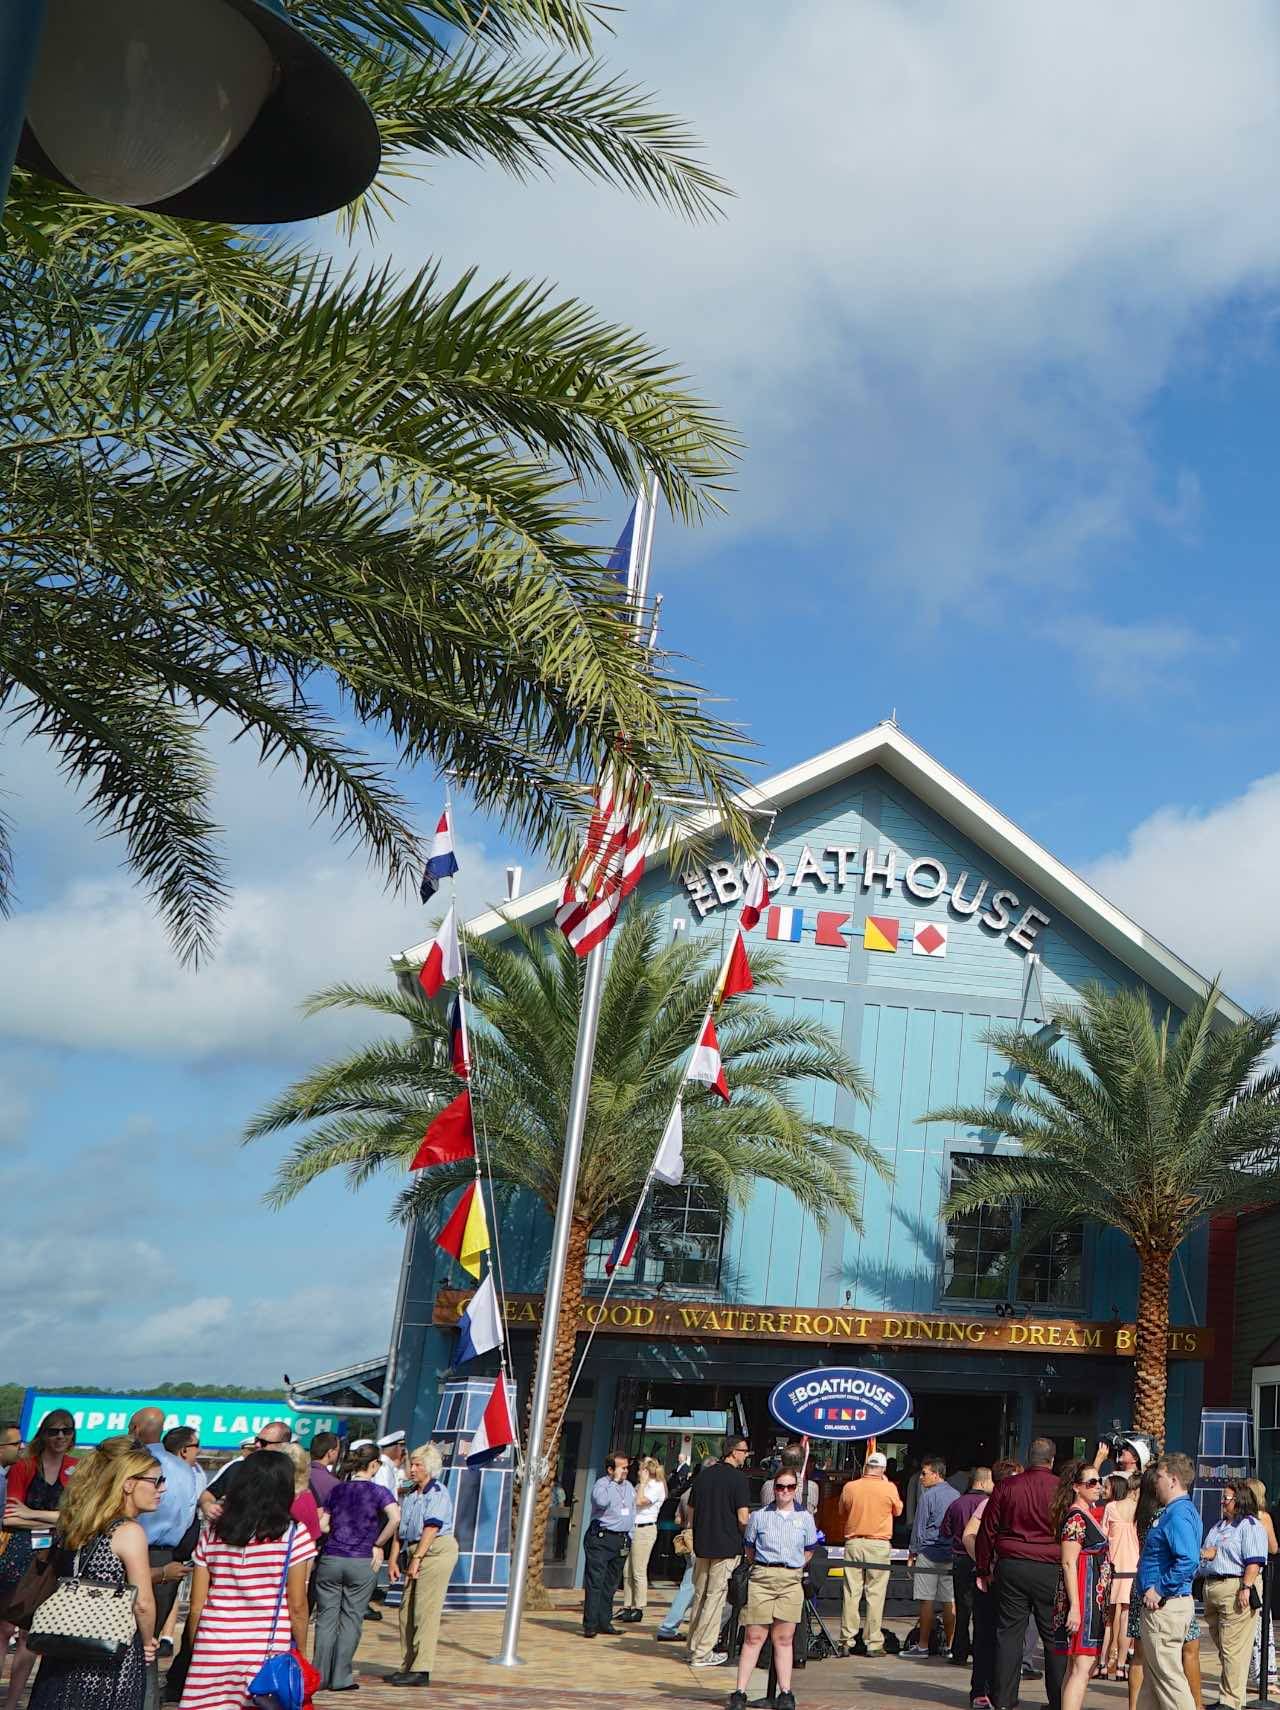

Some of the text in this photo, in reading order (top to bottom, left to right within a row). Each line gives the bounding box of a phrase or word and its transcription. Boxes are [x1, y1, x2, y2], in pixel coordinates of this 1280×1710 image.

[708, 842, 1051, 951] BOATHOUSE
[679, 1307, 872, 1338] WATERFRONT
[882, 1317, 985, 1343] DINING
[1008, 1323, 1102, 1348] DREAM
[1114, 1329, 1198, 1353] BTS
[795, 1378, 896, 1407] BOATHOUSE
